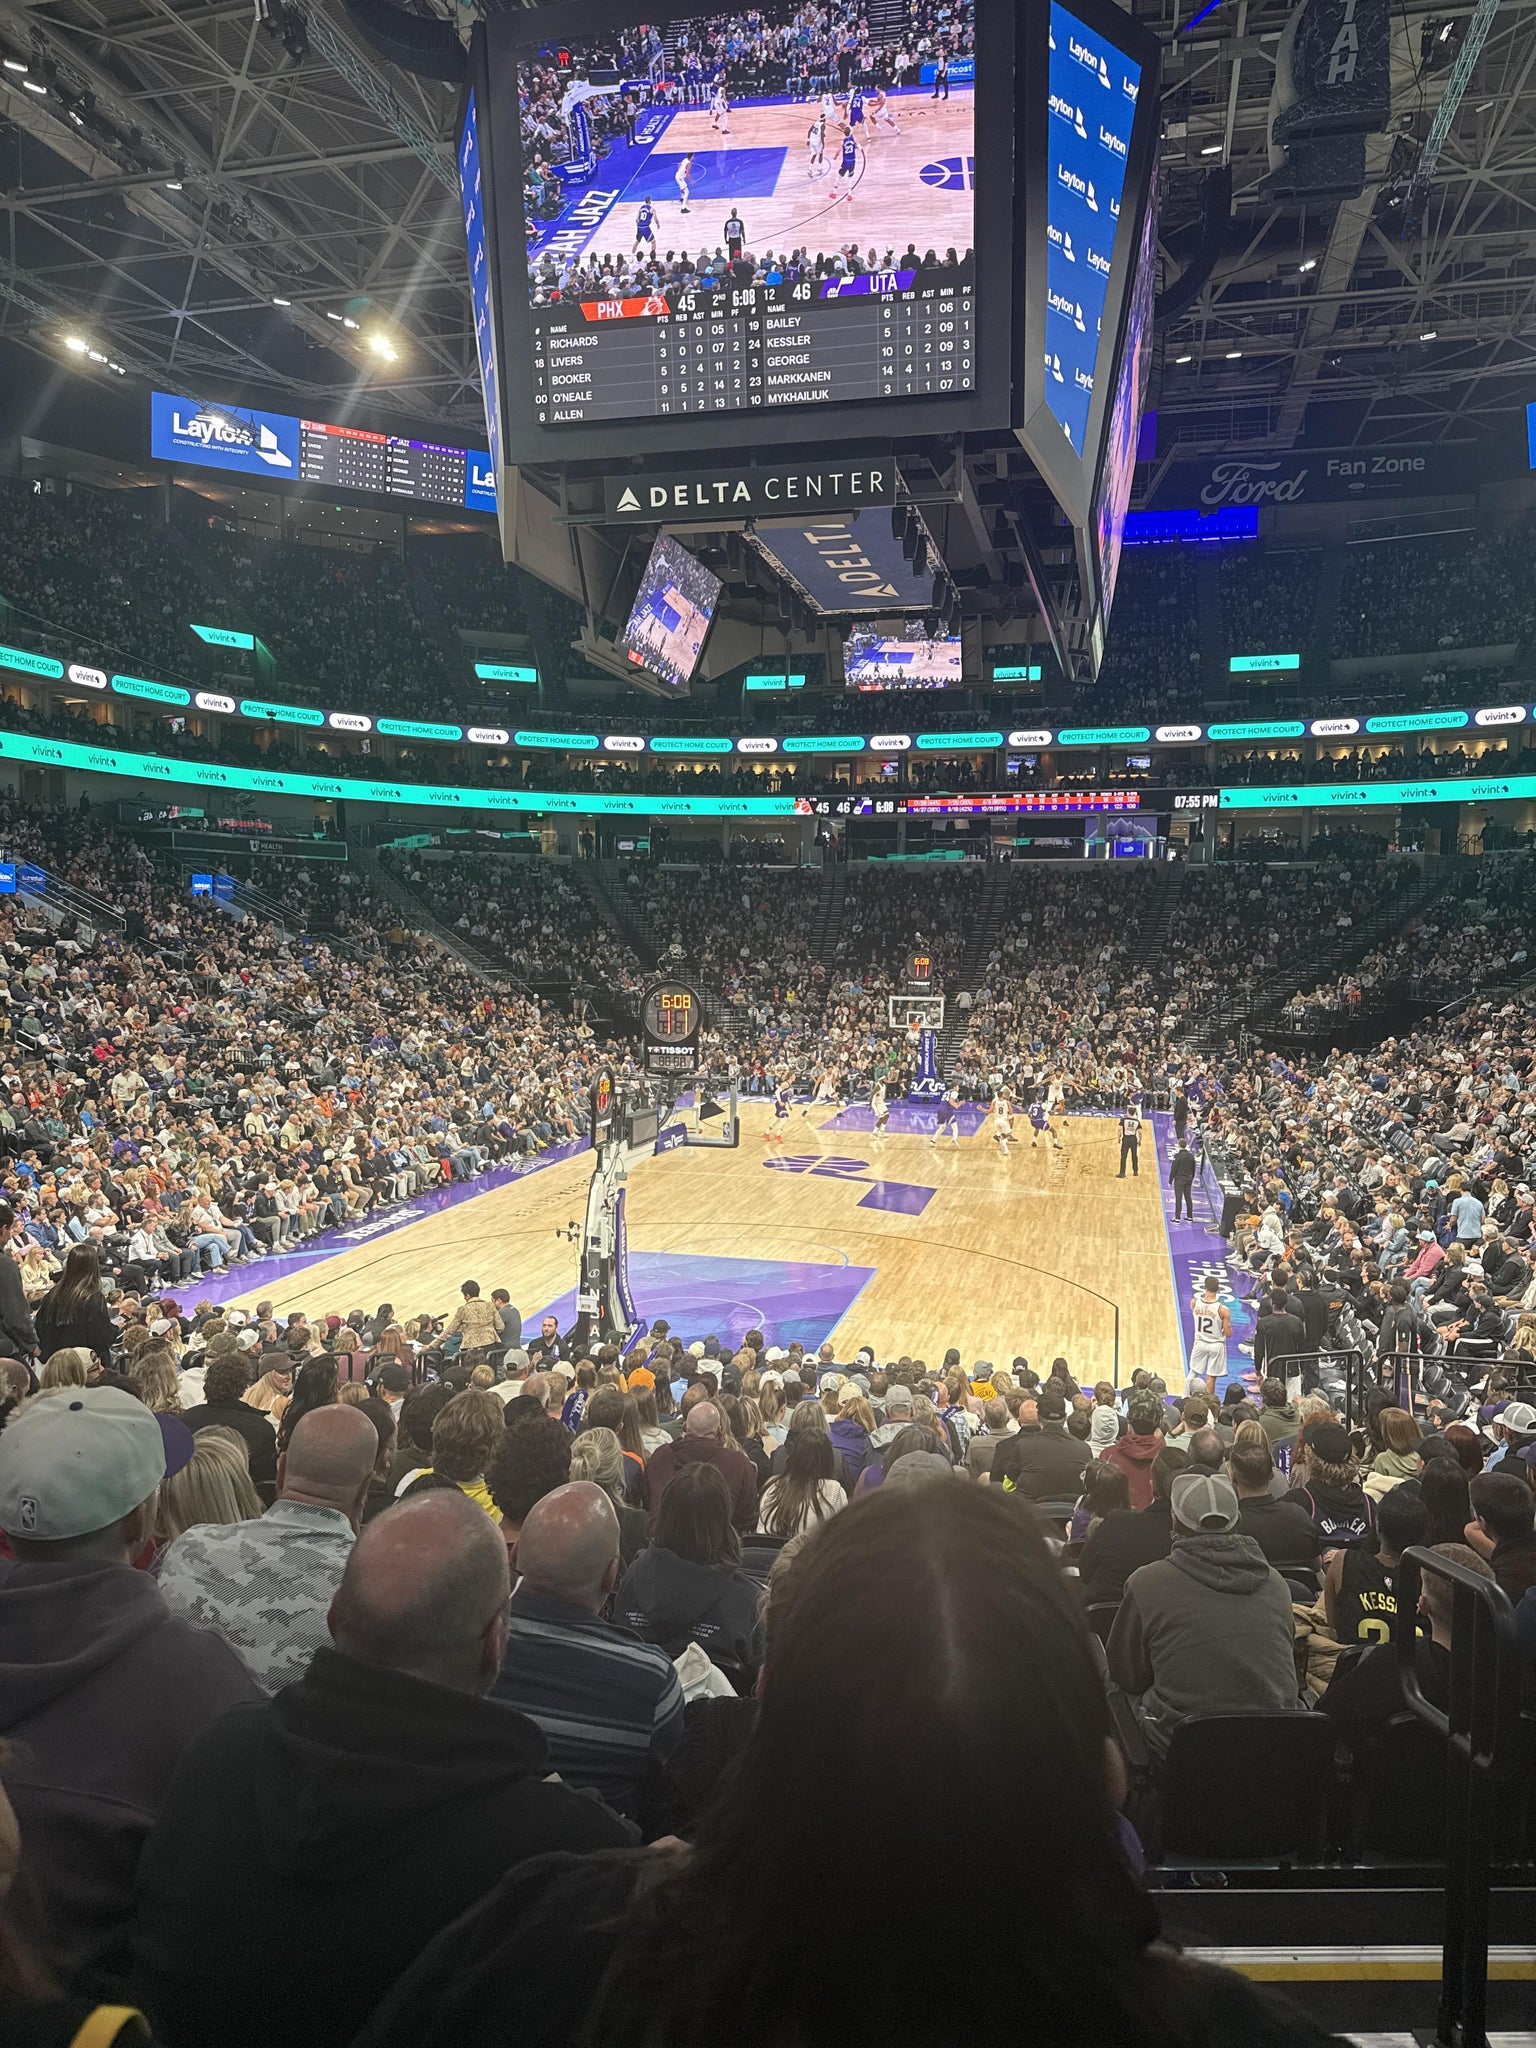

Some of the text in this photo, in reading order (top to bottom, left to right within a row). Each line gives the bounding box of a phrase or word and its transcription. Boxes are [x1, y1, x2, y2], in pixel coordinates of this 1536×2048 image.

[1069, 36, 1098, 69] Layton
[1124, 76, 1138, 97] Lay
[1048, 94, 1073, 120] ayton
[1100, 126, 1126, 155] Layton
[1058, 165, 1086, 192] Layton
[576, 189, 619, 227] JAZZ
[598, 301, 624, 319] PHX
[678, 295, 695, 311] 45
[733, 289, 755, 306] 6:08
[764, 289, 775, 301] 12
[793, 284, 811, 300] 46
[870, 274, 898, 292] UTA
[767, 288, 953, 312] NAME PTS REB AST MIN
[1048, 289, 1074, 315] Layton
[550, 325, 567, 333] NAME
[657, 315, 669, 323] PTS
[693, 312, 704, 320] AST
[711, 310, 723, 318] MIN
[748, 302, 954, 330] 19 BAILEY 6 1 1 06
[536, 324, 724, 350] 2 RICHARDS 4 5 0 05
[748, 322, 954, 349] 24 KESSLER 5 1 2 09
[534, 342, 724, 368] 18 LIVERS 3 0 0 07
[752, 341, 953, 368] 3 GEORGE 10 0 2 09
[538, 361, 723, 386] 1 BOOKER 5 2 4 11
[749, 360, 952, 386] 23 MARKKANEN 14 4 1 13
[535, 380, 725, 404] 00 O'NEALE 9 5 2 14
[750, 379, 953, 404] 10 MYKHAILIUK 3 1 1 07
[539, 398, 725, 422] 8 ALLEN 11 1 2 13
[173, 438, 211, 449] CONSTRUCTING
[224, 447, 249, 456] INTEGRITY
[1327, 455, 1426, 476] Fan Zone
[650, 471, 884, 508] DELTA CENTER
[1200, 461, 1309, 505] Ford
[804, 524, 882, 583] DELT
[209, 633, 230, 643] vivint
[1250, 659, 1272, 667] vivint
[76, 671, 94, 682] vivint
[116, 679, 186, 700] PROTECT HOME COURT
[337, 717, 357, 727] vivint
[1372, 715, 1463, 728] PROTECT HOME COURT
[1485, 712, 1508, 721] vivint
[1320, 723, 1343, 732] vivint
[32, 745, 55, 757] vivint
[197, 770, 219, 780] vivint
[312, 783, 334, 793] vivint
[430, 792, 453, 802] vivint
[1331, 791, 1358, 800] vivint
[1472, 785, 1500, 794] vivint
[546, 799, 570, 808] vivint
[719, 803, 742, 811] vivint
[816, 802, 894, 813] 45 46 6:08
[1175, 795, 1218, 808] 07:55 PM
[662, 994, 691, 1008] 6:08
[1198, 1316, 1213, 1334] 12
